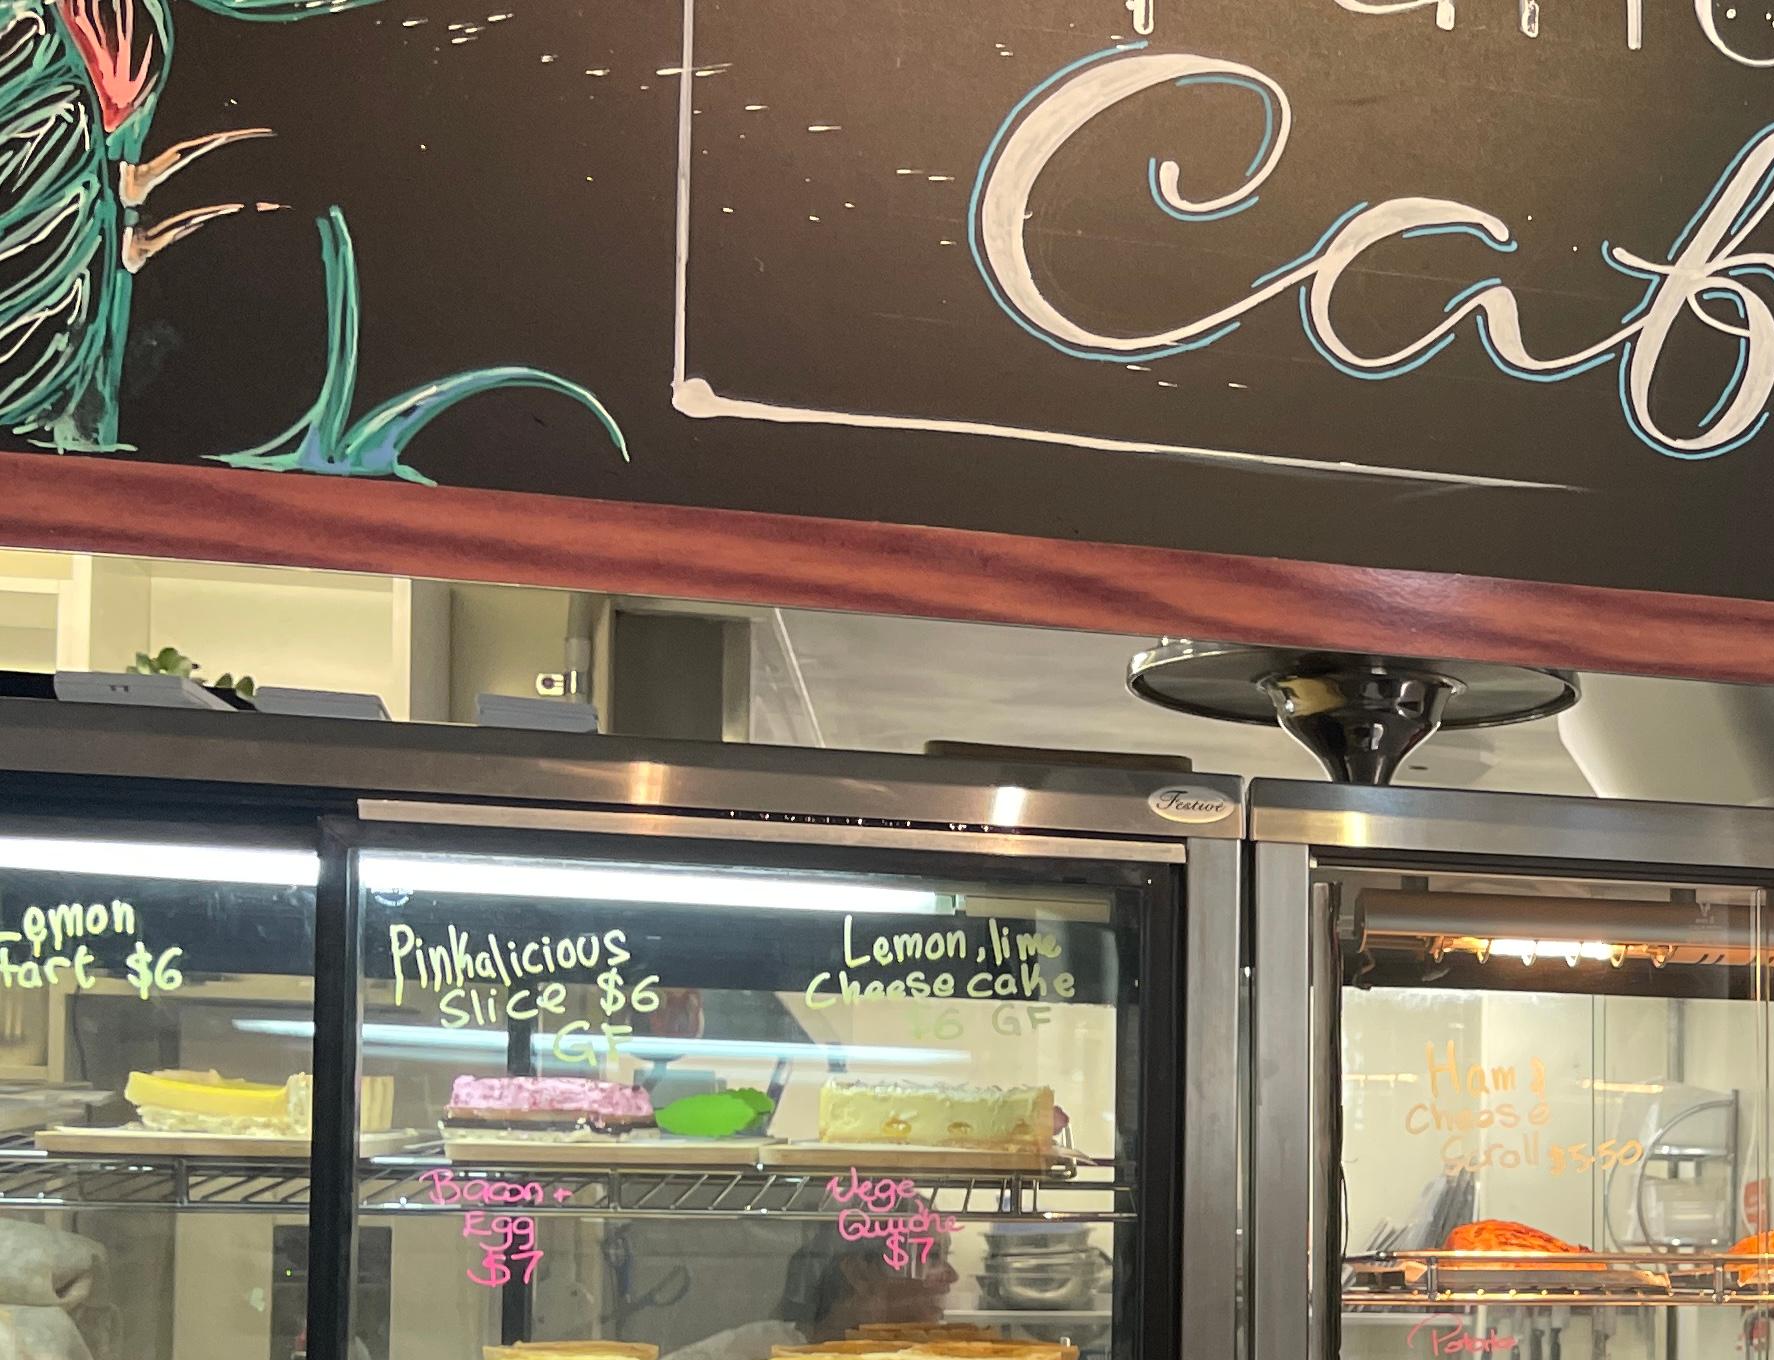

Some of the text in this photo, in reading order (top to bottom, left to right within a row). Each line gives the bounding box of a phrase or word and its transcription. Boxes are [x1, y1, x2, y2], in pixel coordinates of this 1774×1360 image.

[126, 942, 183, 999] $6
[389, 924, 631, 1006] Pinkalicious
[440, 967, 660, 1029] Slice $6
[991, 1005, 1053, 1037] GF
[553, 1022, 634, 1068] GF
[1424, 1040, 1517, 1098] Ham
[419, 1168, 543, 1206] Bacon
[826, 1168, 918, 1212] Vege
[463, 1211, 535, 1251] Egg
[883, 1236, 936, 1270] $7
[467, 1250, 543, 1288] $7
